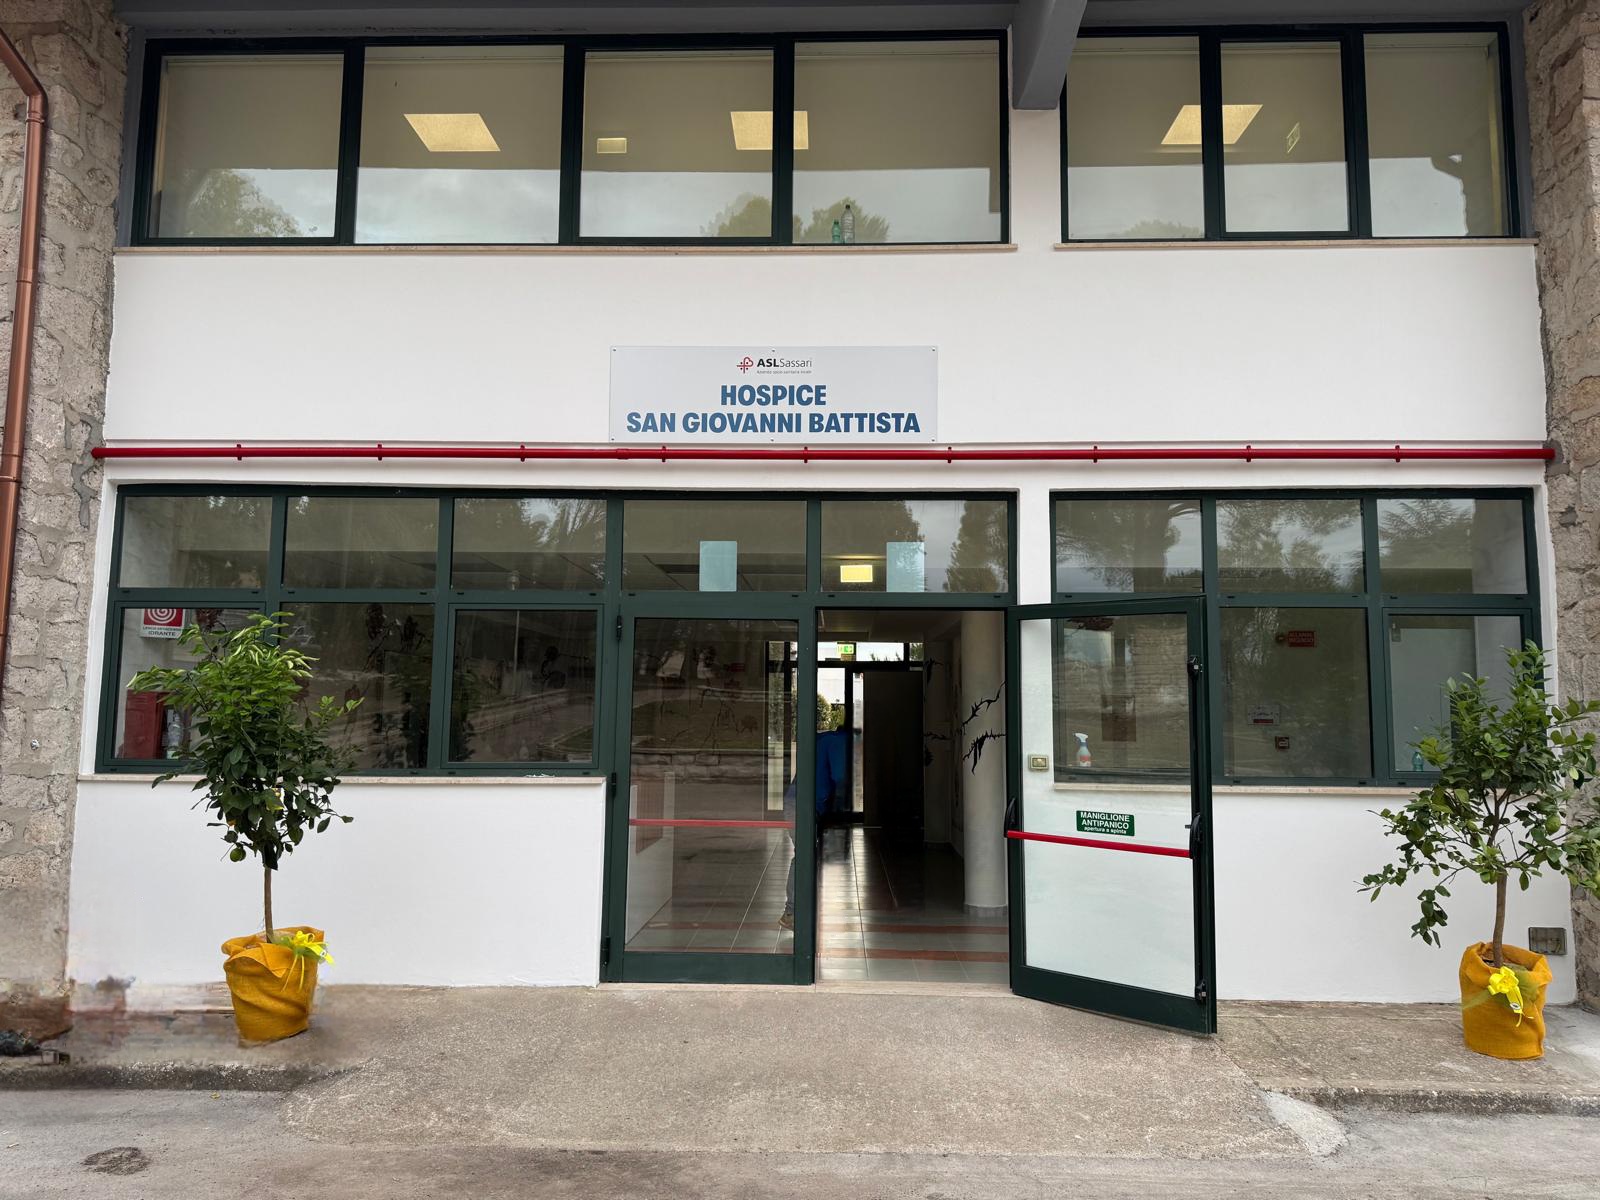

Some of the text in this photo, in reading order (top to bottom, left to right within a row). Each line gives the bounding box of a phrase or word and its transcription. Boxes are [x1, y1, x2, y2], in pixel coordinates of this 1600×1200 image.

[720, 384, 827, 406] HOSPICE
[626, 411, 921, 433] SAN GIOVANNI BATTISTA
[1080, 811, 1130, 822] MANIGLIONE
[1081, 819, 1129, 830] ANTIPANICO
